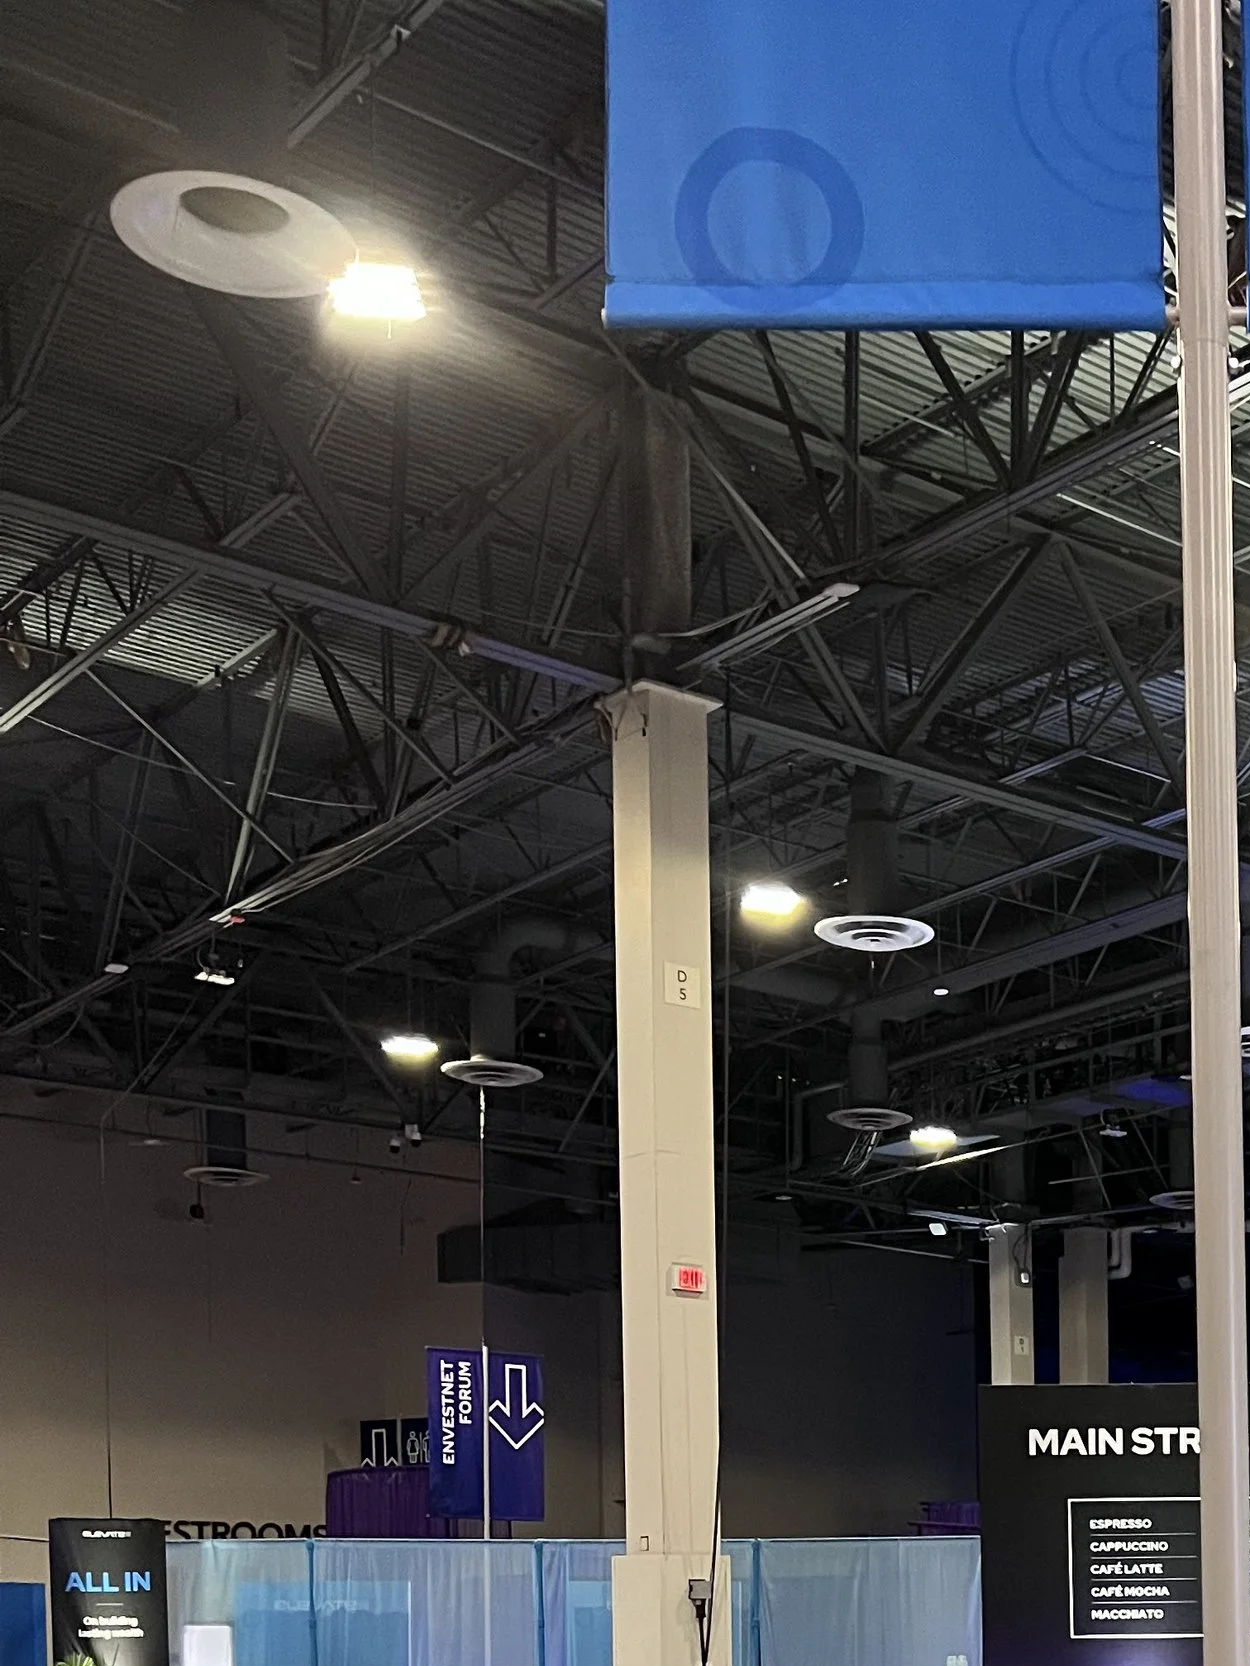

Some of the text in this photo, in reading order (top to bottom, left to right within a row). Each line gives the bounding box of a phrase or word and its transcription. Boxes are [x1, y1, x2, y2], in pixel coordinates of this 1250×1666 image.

[678, 969, 688, 983] D
[679, 988, 687, 1001] 5
[458, 1361, 472, 1425] FORUM
[440, 1359, 455, 1465] ENVESTNET
[1028, 1428, 1124, 1456] MAIN
[1089, 1519, 1153, 1530] ESPRESSO
[1089, 1541, 1169, 1552] CAPPUCCINO
[1089, 1561, 1164, 1575] CAFÉ LATTE
[65, 1571, 151, 1593] ALL IN
[1090, 1584, 1171, 1598] CAFÉ MOCHA
[1091, 1609, 1165, 1620] MACCHIATO
